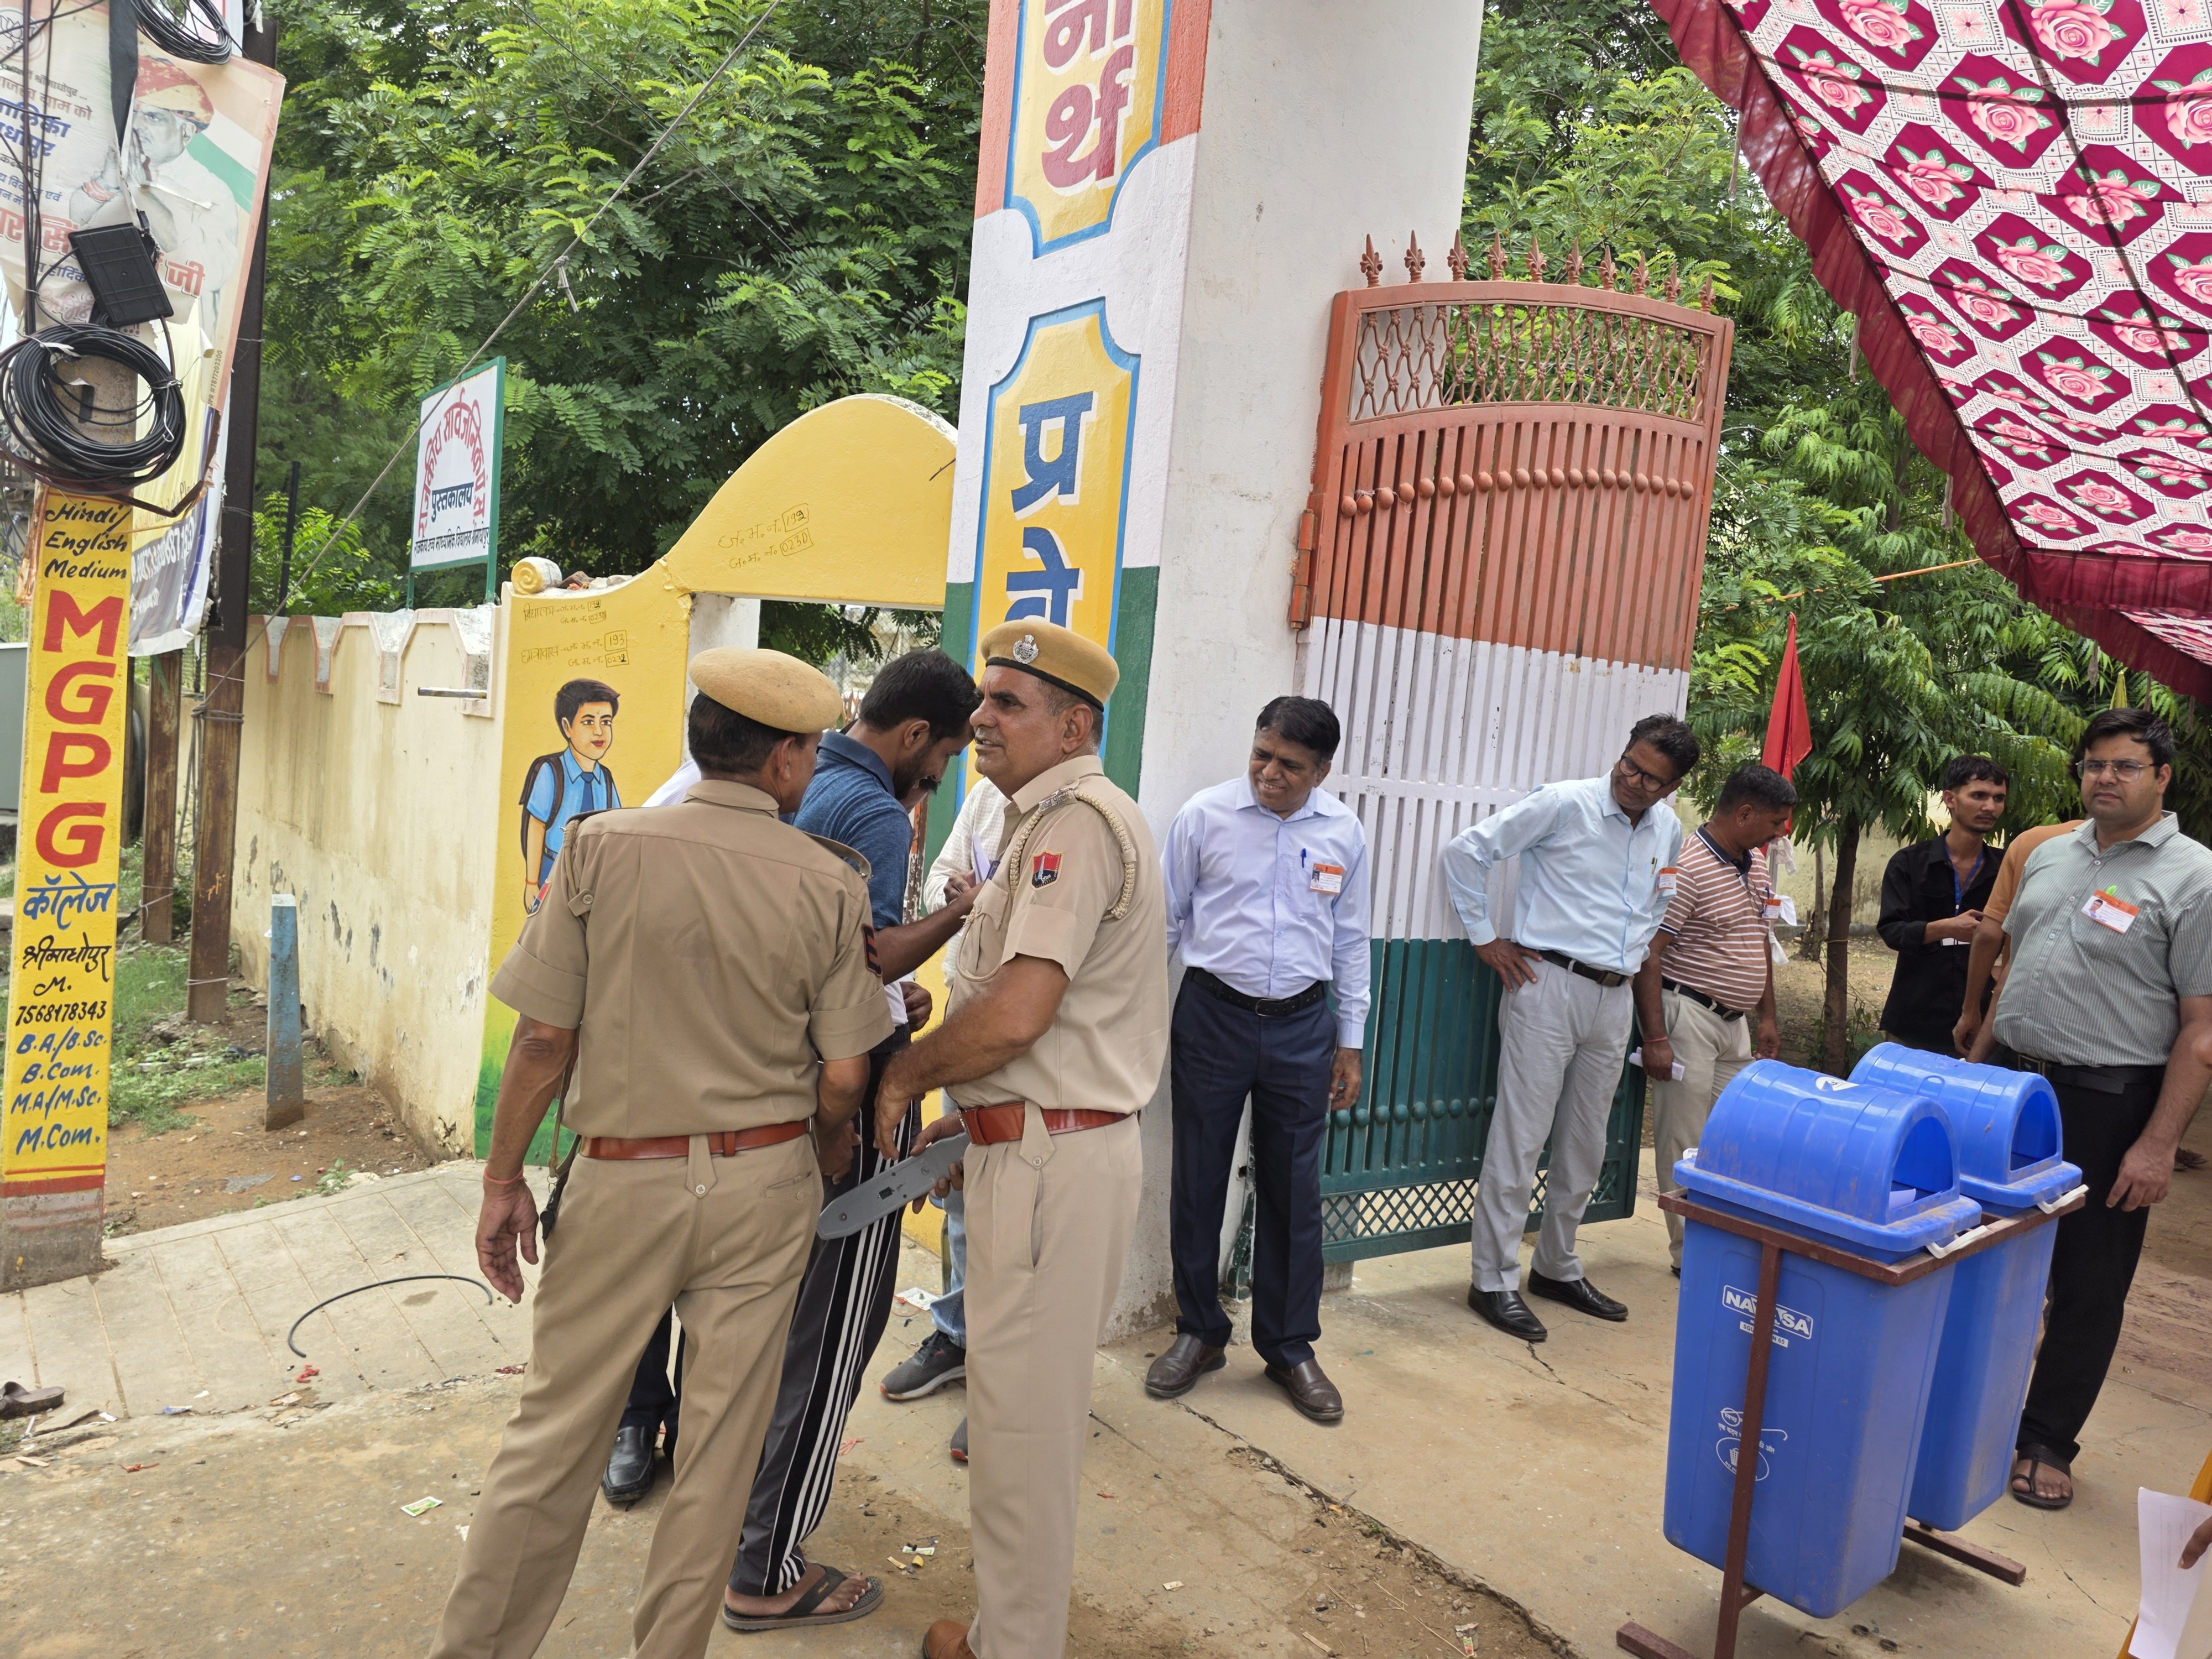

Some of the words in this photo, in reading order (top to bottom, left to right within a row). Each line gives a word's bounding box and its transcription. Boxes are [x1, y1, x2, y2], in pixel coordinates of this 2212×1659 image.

[74, 105, 93, 121] को
[166, 260, 205, 297] जी
[431, 482, 474, 522] पुस्तकालय
[45, 531, 128, 556] English
[44, 559, 127, 580] Medium
[609, 633, 624, 646] 193
[23, 870, 116, 930] कॉलेज
[22, 931, 112, 982] श्रीमाधोपुर
